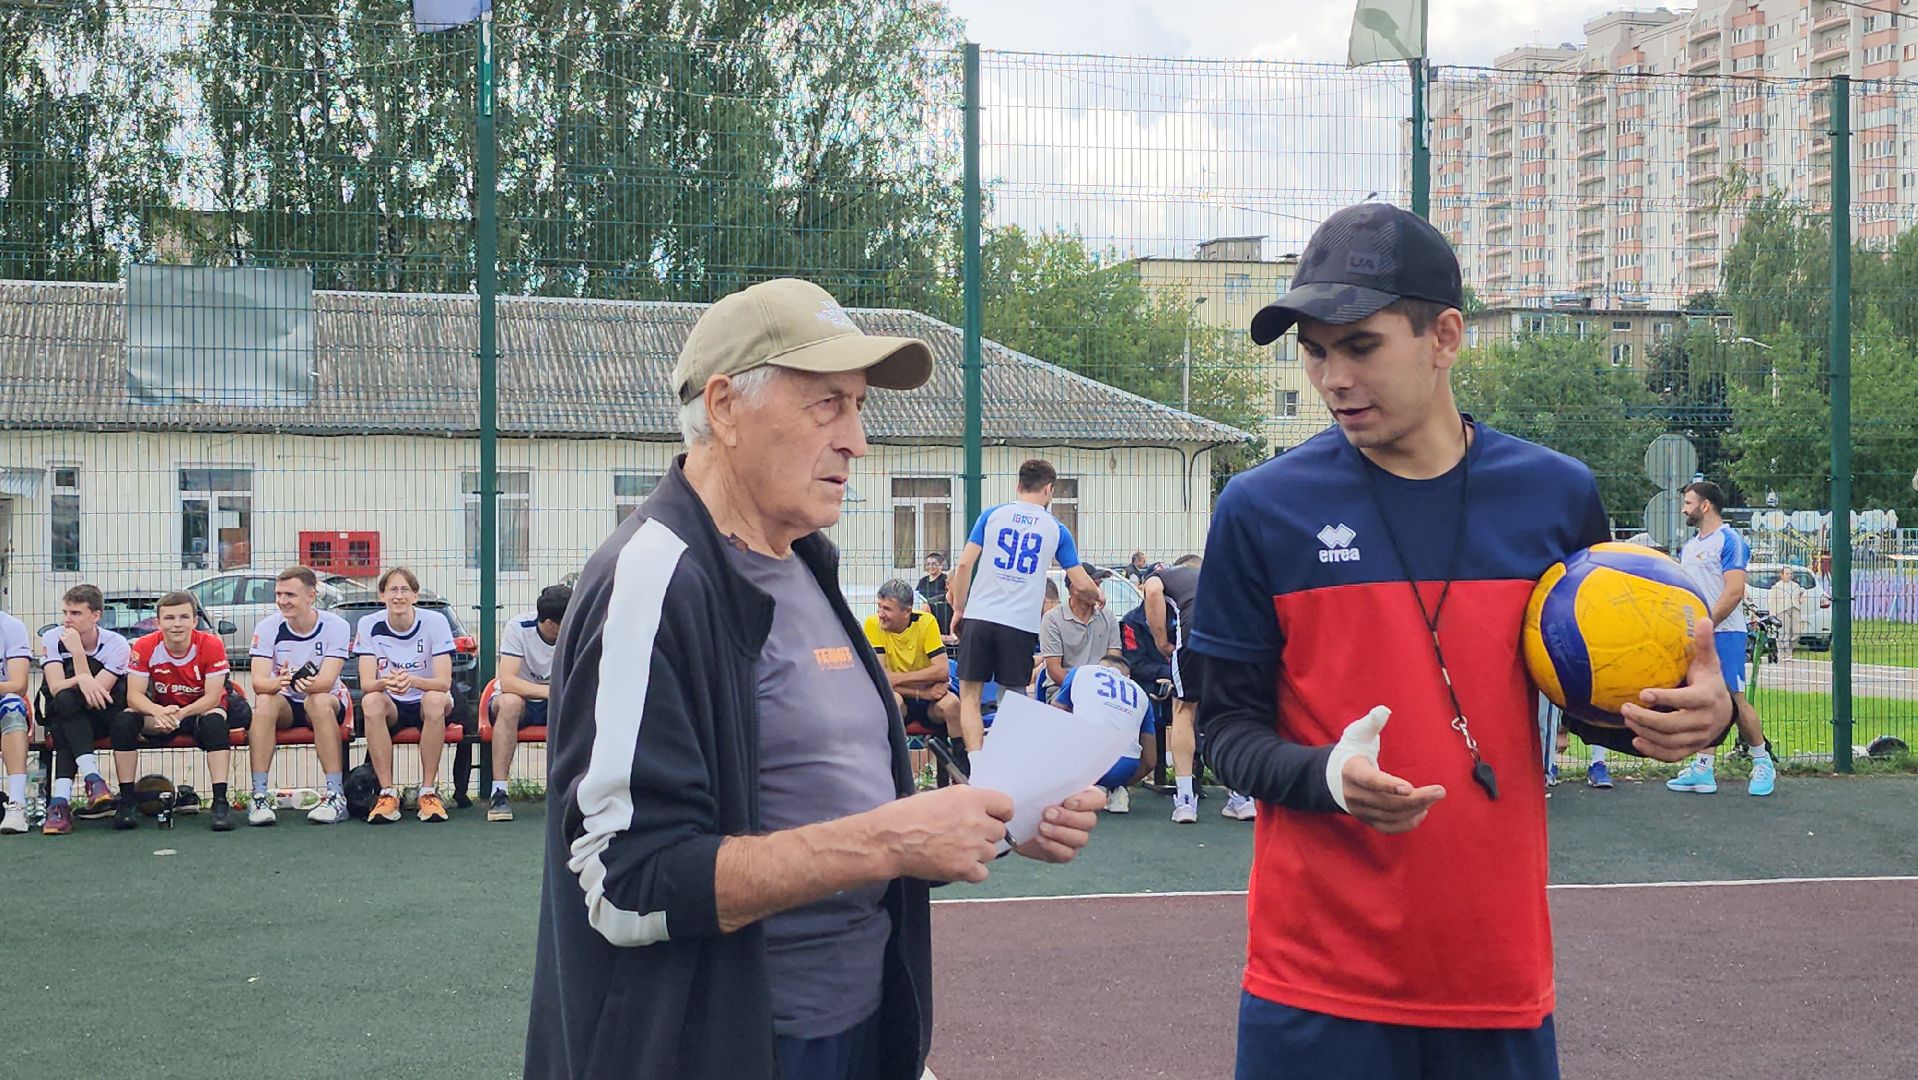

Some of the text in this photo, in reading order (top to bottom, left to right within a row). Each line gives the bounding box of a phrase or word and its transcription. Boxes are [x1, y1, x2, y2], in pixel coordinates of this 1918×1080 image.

[994, 527, 1043, 575] 98
[315, 641, 323, 656] 9
[416, 639, 424, 654] 6
[193, 665, 202, 681] 1
[1095, 672, 1138, 709] 30
